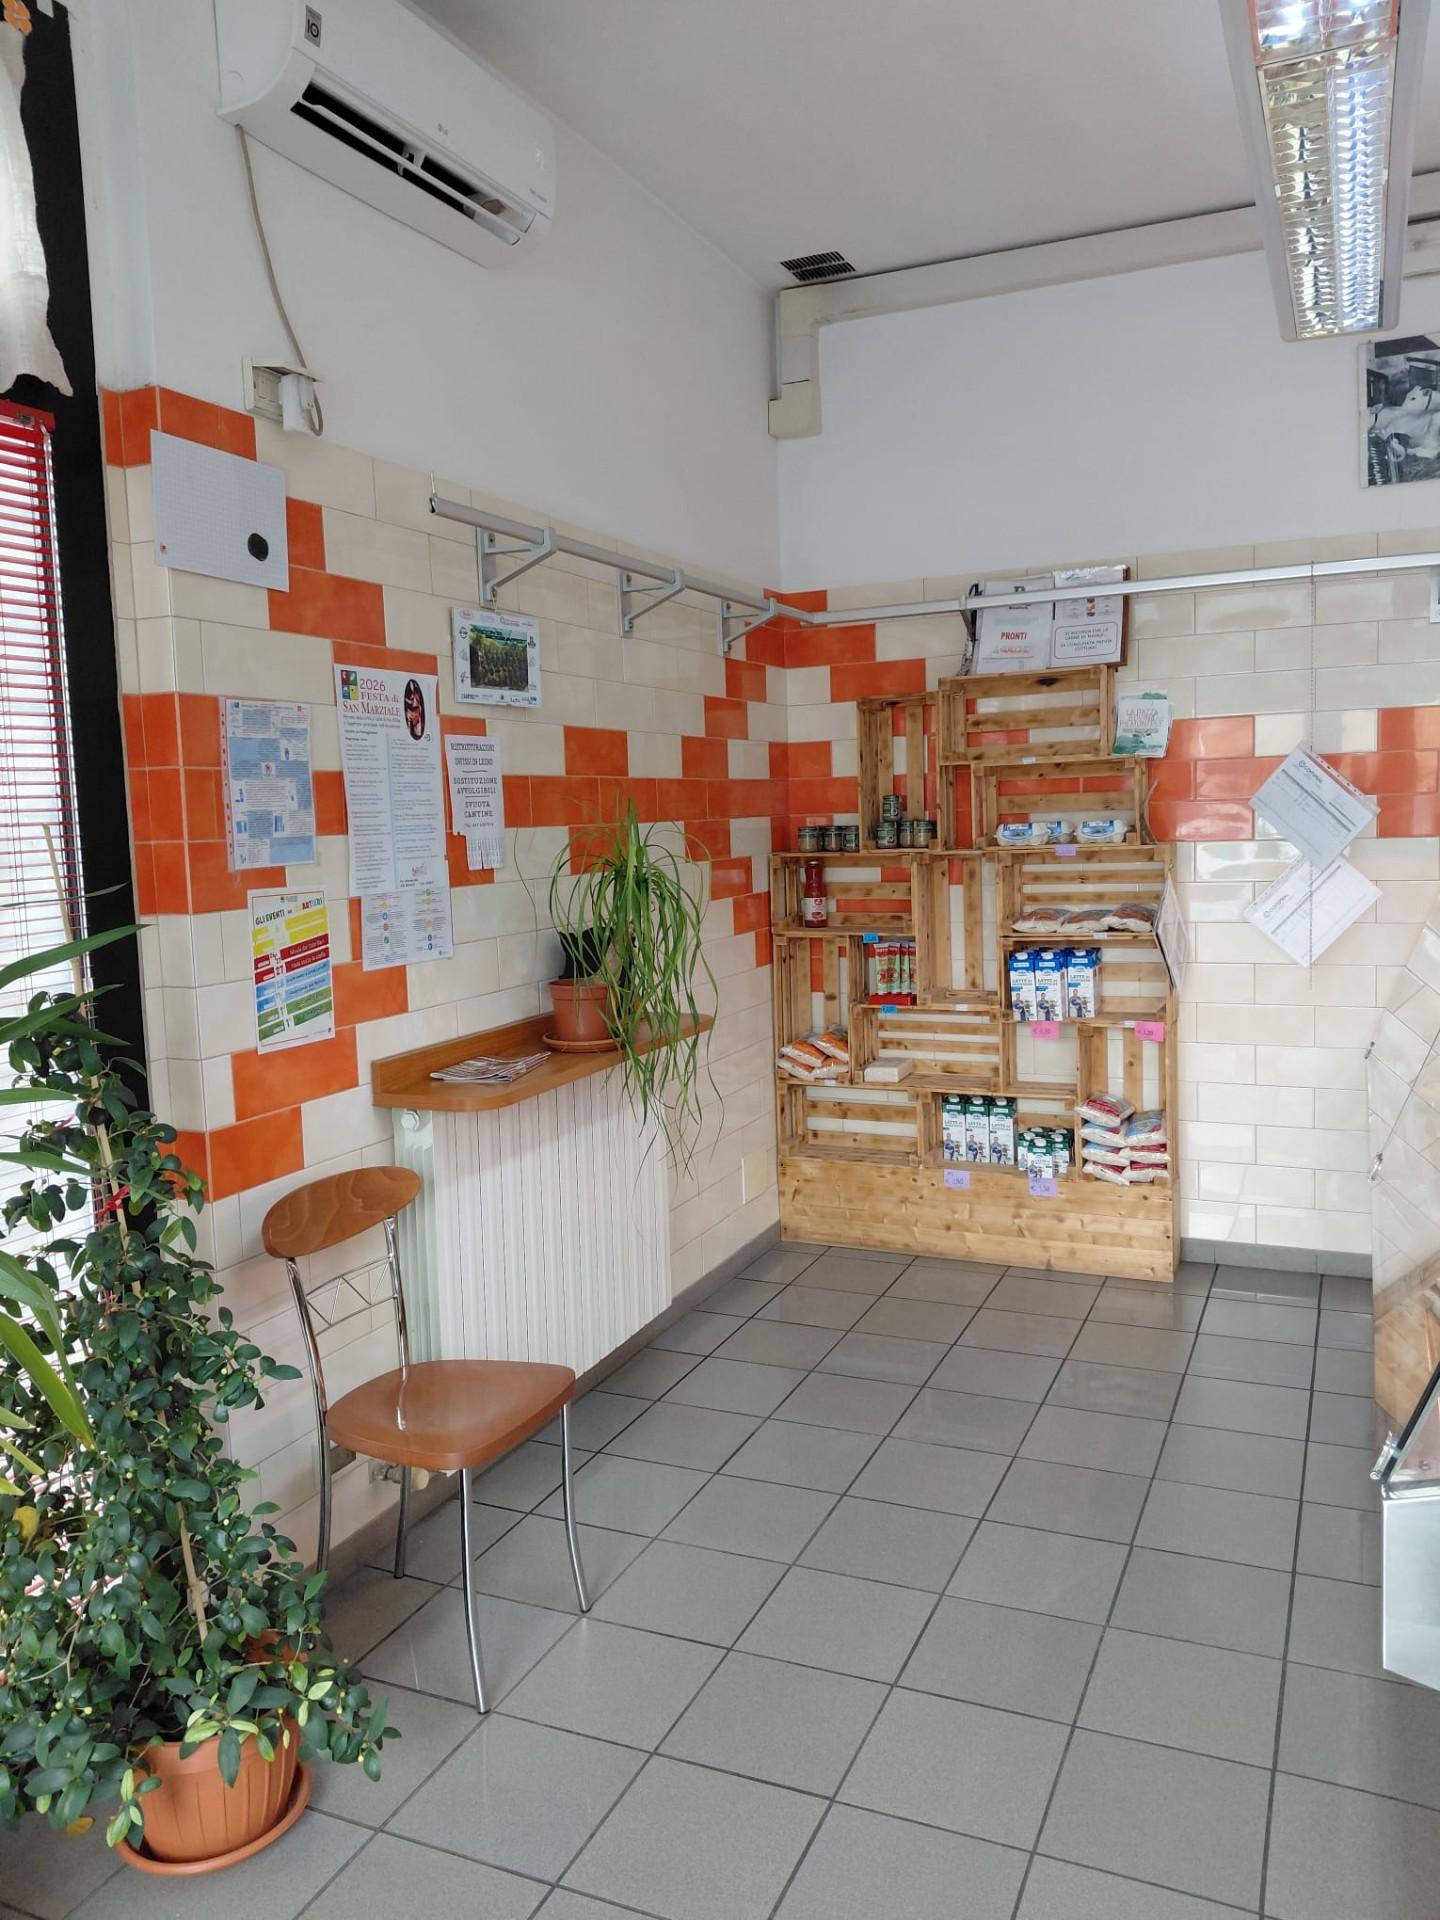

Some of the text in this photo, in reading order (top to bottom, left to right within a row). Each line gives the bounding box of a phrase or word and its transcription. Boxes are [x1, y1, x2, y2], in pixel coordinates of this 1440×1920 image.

[1000, 631, 1028, 641] PRONTI
[360, 678, 386, 692] 2026
[361, 691, 400, 703] FESTA di
[343, 700, 401, 717] SAN MARZIALE
[453, 776, 498, 785] SOSTITUZIONE
[456, 786, 497, 795] AVVOLGIBILI
[464, 800, 491, 809] SVUOTA
[463, 810, 494, 818] CANTINE
[255, 915, 265, 926] GLI
[275, 964, 284, 976] 27
